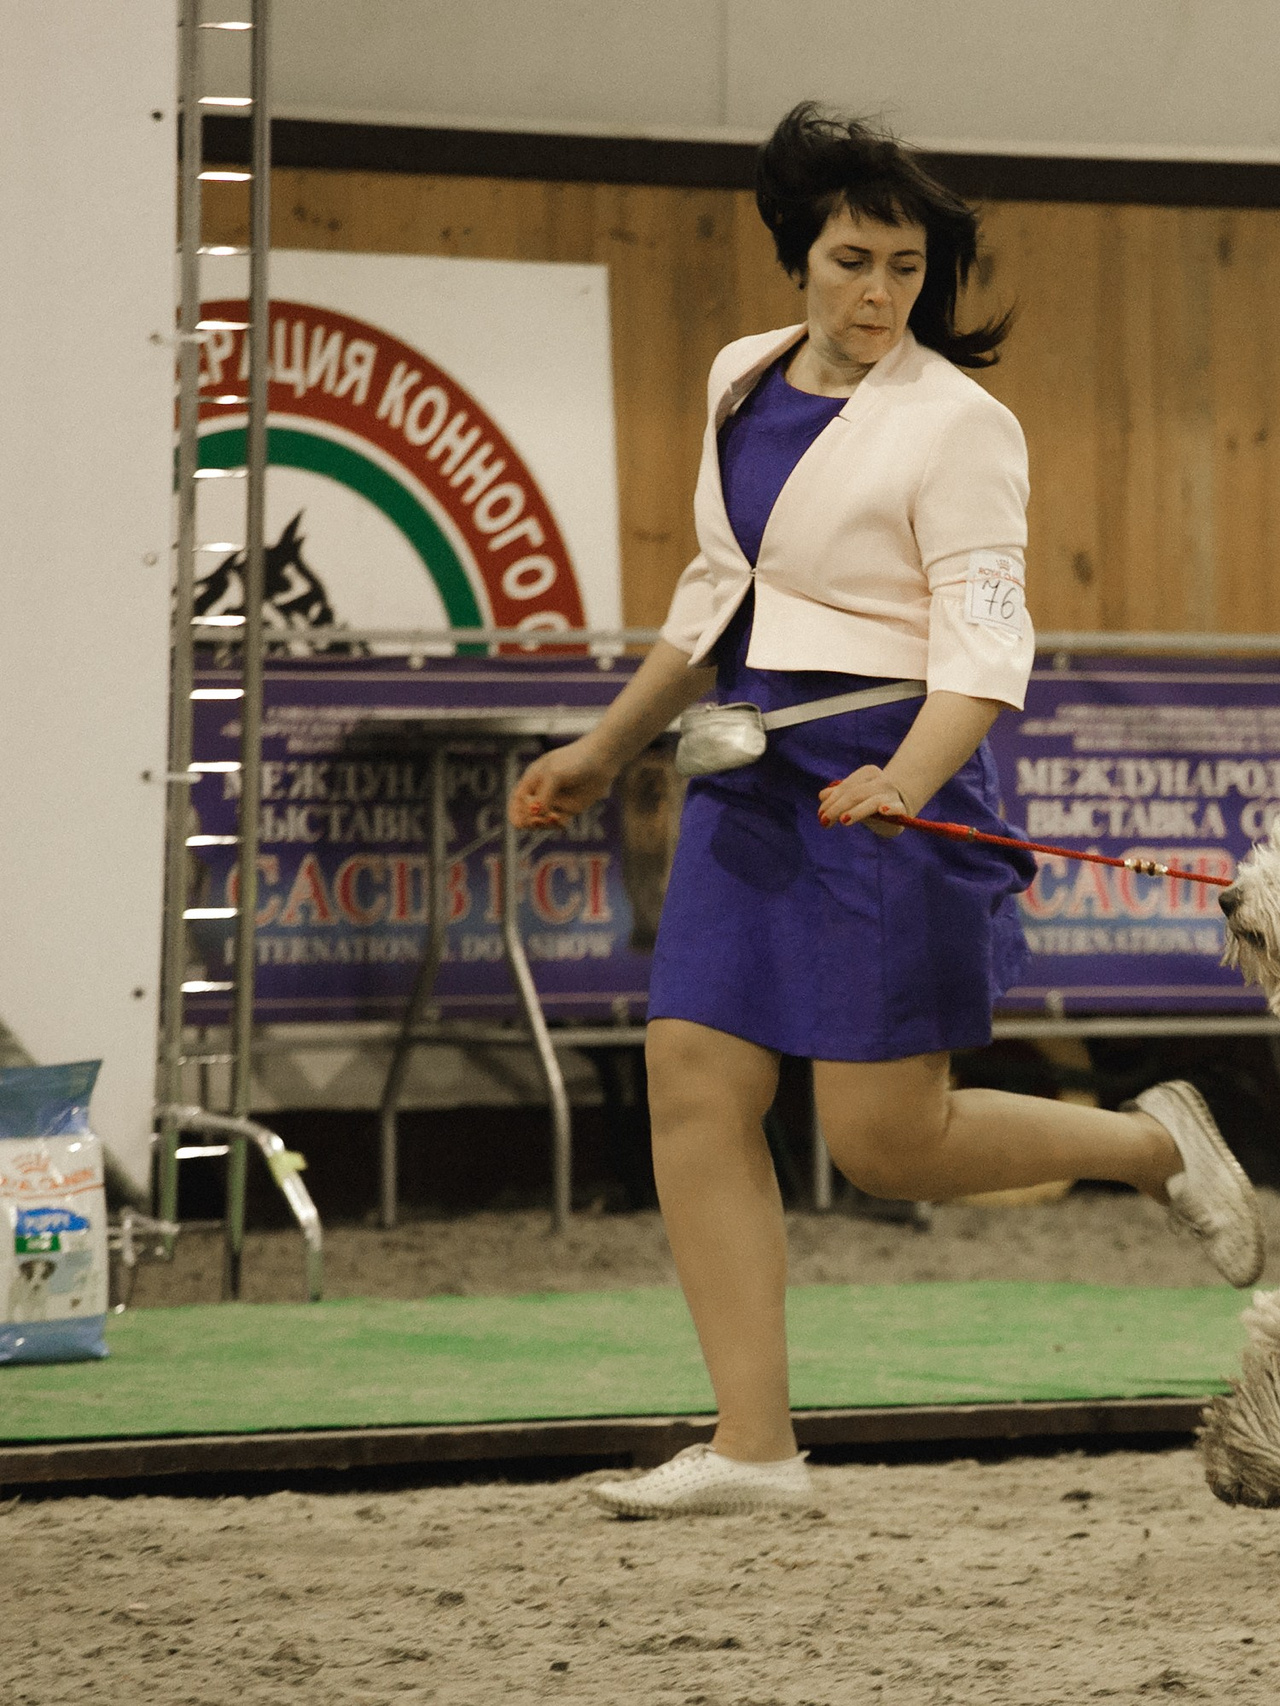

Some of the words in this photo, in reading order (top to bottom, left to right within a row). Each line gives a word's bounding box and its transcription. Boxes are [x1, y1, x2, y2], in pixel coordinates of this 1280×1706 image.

[376, 360, 557, 600] КОННОГО
[982, 579, 1016, 619] 76
[1026, 800, 1226, 838] ВЫСТАВКА
